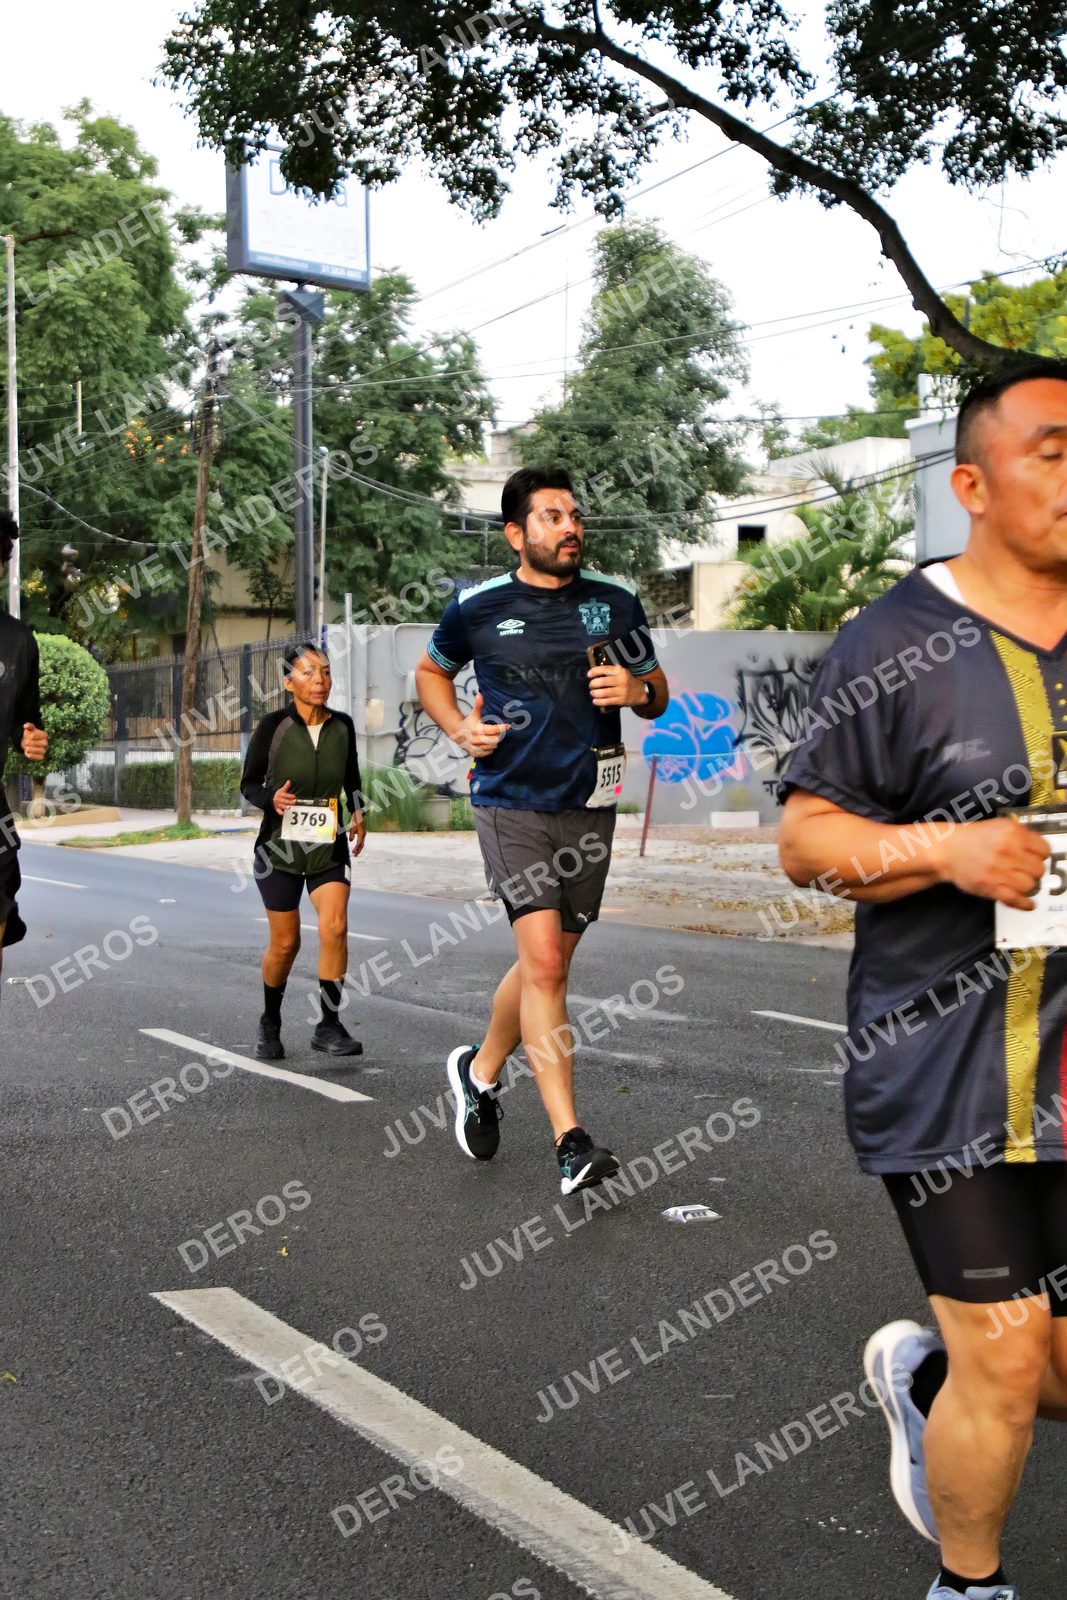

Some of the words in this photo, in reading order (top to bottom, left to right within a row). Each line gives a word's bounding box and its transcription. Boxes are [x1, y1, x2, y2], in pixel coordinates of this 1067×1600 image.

[499, 628, 524, 637] umbro
[600, 763, 622, 788] 5515
[290, 811, 327, 827] 3769
